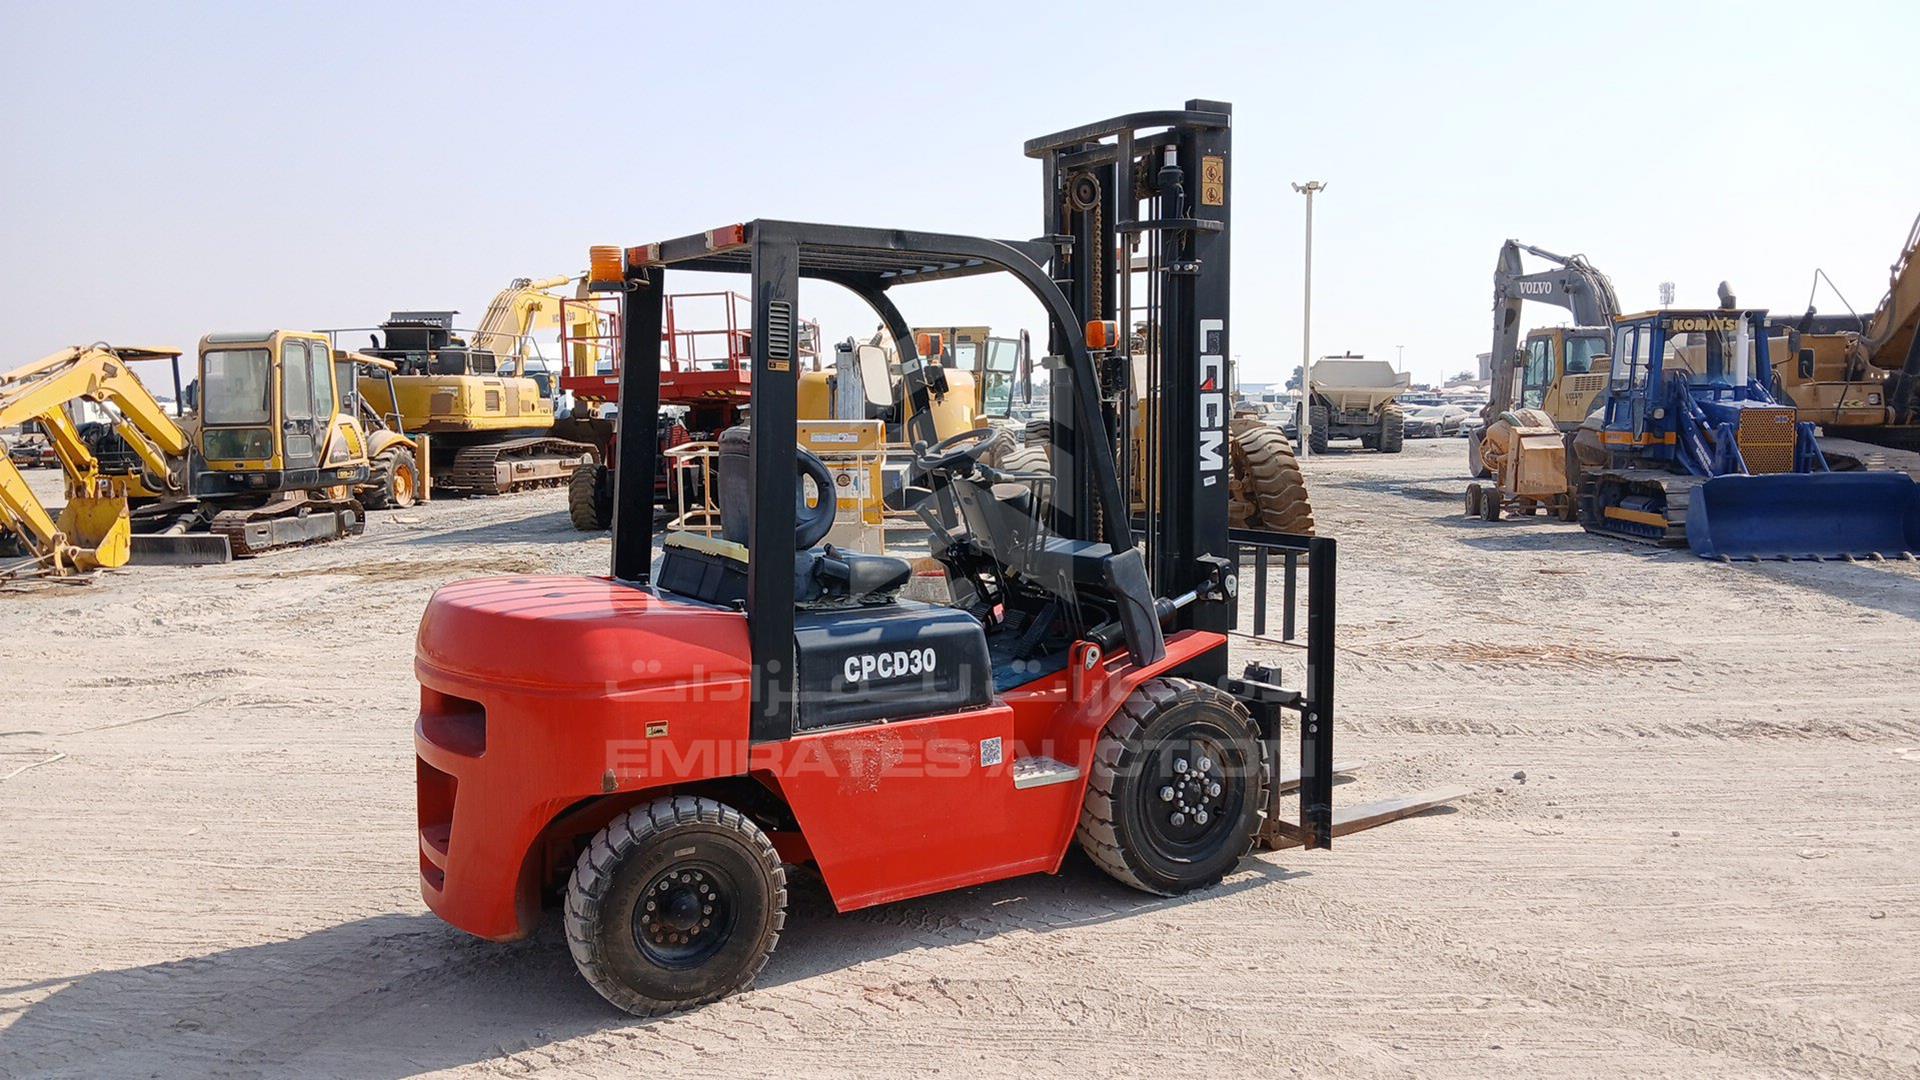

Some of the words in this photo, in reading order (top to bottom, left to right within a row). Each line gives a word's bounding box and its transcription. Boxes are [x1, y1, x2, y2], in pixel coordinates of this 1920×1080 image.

[1519, 282, 1552, 294] VOLVO
[1673, 318, 1738, 331] KOMATS
[844, 648, 936, 682] CPCD30
